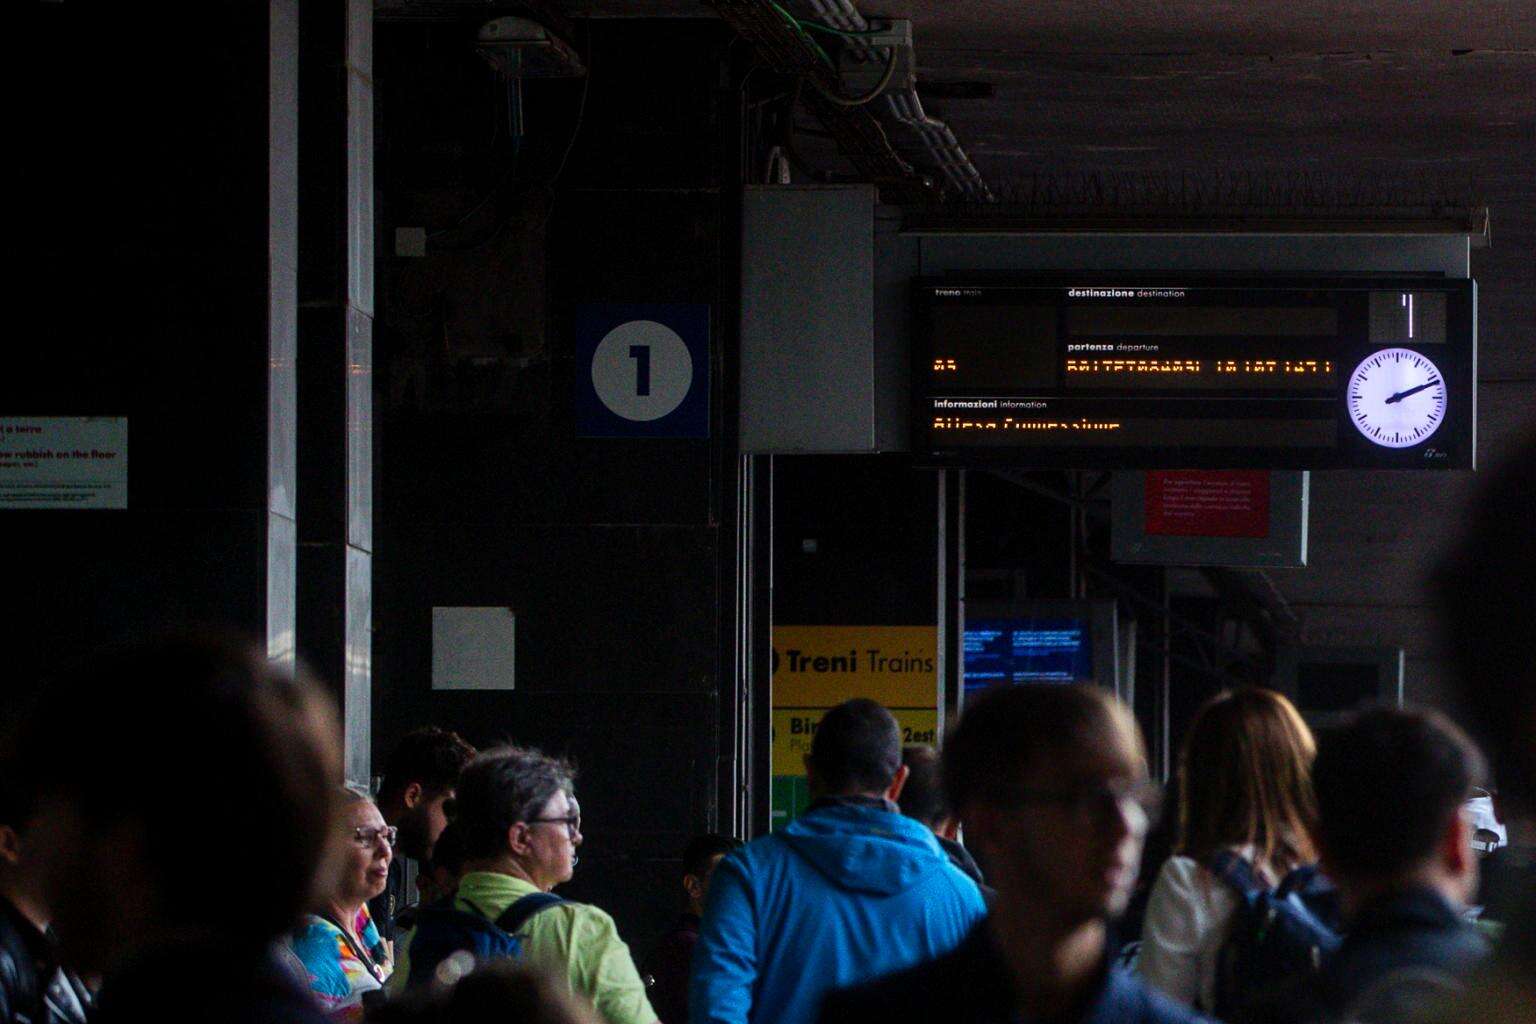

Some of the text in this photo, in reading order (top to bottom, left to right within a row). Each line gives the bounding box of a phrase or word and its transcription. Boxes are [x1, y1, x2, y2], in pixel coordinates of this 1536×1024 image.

[1068, 287, 1185, 299] destinazione destination
[1067, 341, 1159, 352] partenza departure
[629, 345, 650, 396] 1
[15, 448, 54, 459] rubbish
[72, 448, 89, 459] the
[90, 448, 117, 459] floor
[787, 649, 935, 673] Treni Trains
